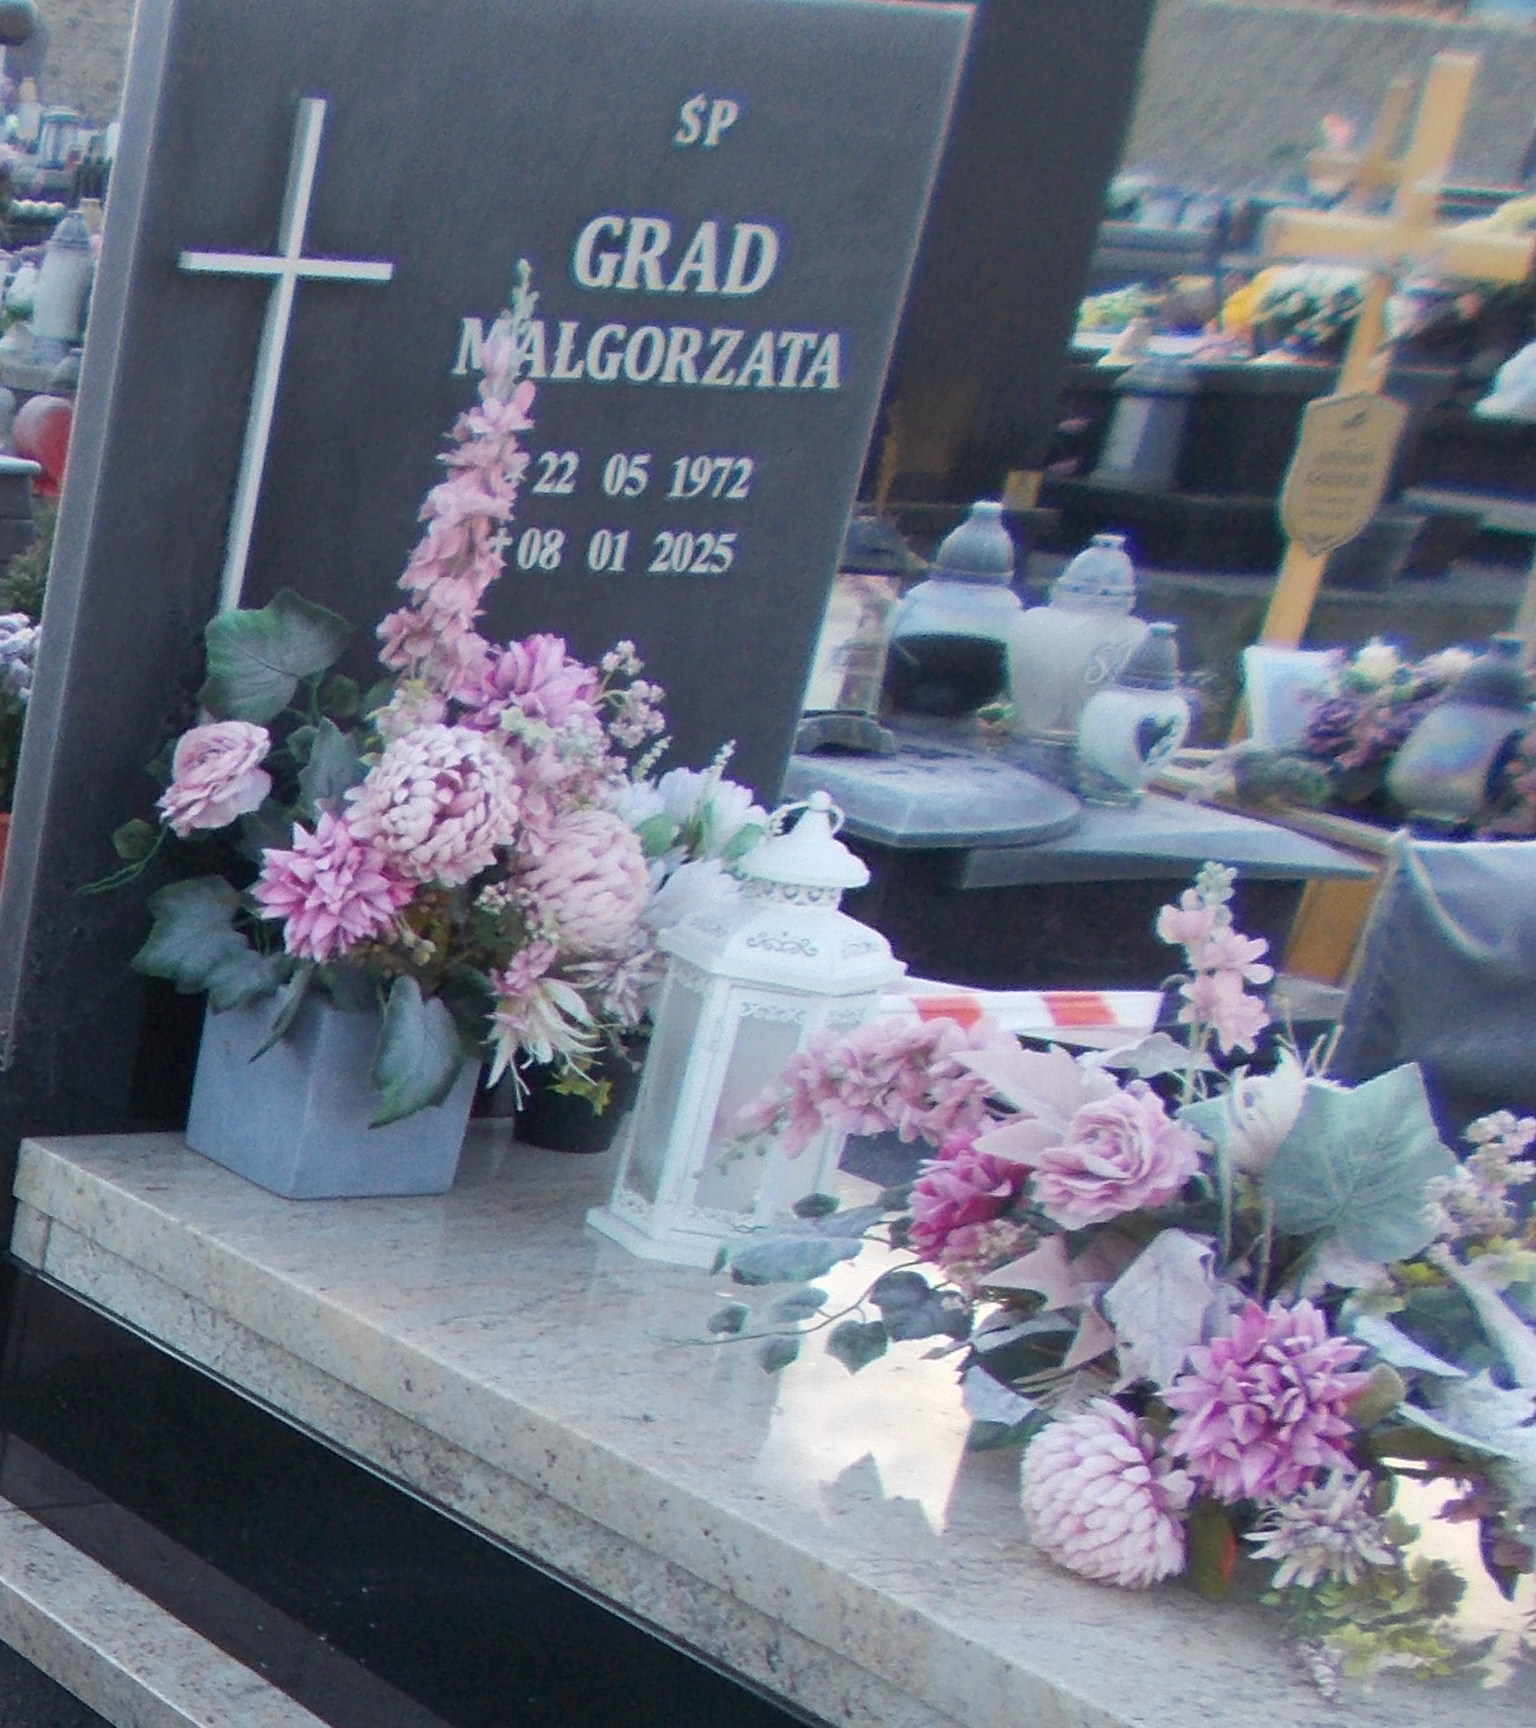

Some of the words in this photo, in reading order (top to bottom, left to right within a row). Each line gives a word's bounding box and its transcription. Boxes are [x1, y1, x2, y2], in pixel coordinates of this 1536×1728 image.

[573, 215, 780, 295] GRAD
[532, 450, 579, 495] 22
[602, 453, 651, 497] 05
[666, 456, 755, 500] 1972
[515, 527, 564, 570] 08
[587, 529, 632, 572] 01
[647, 532, 738, 574] 2025
